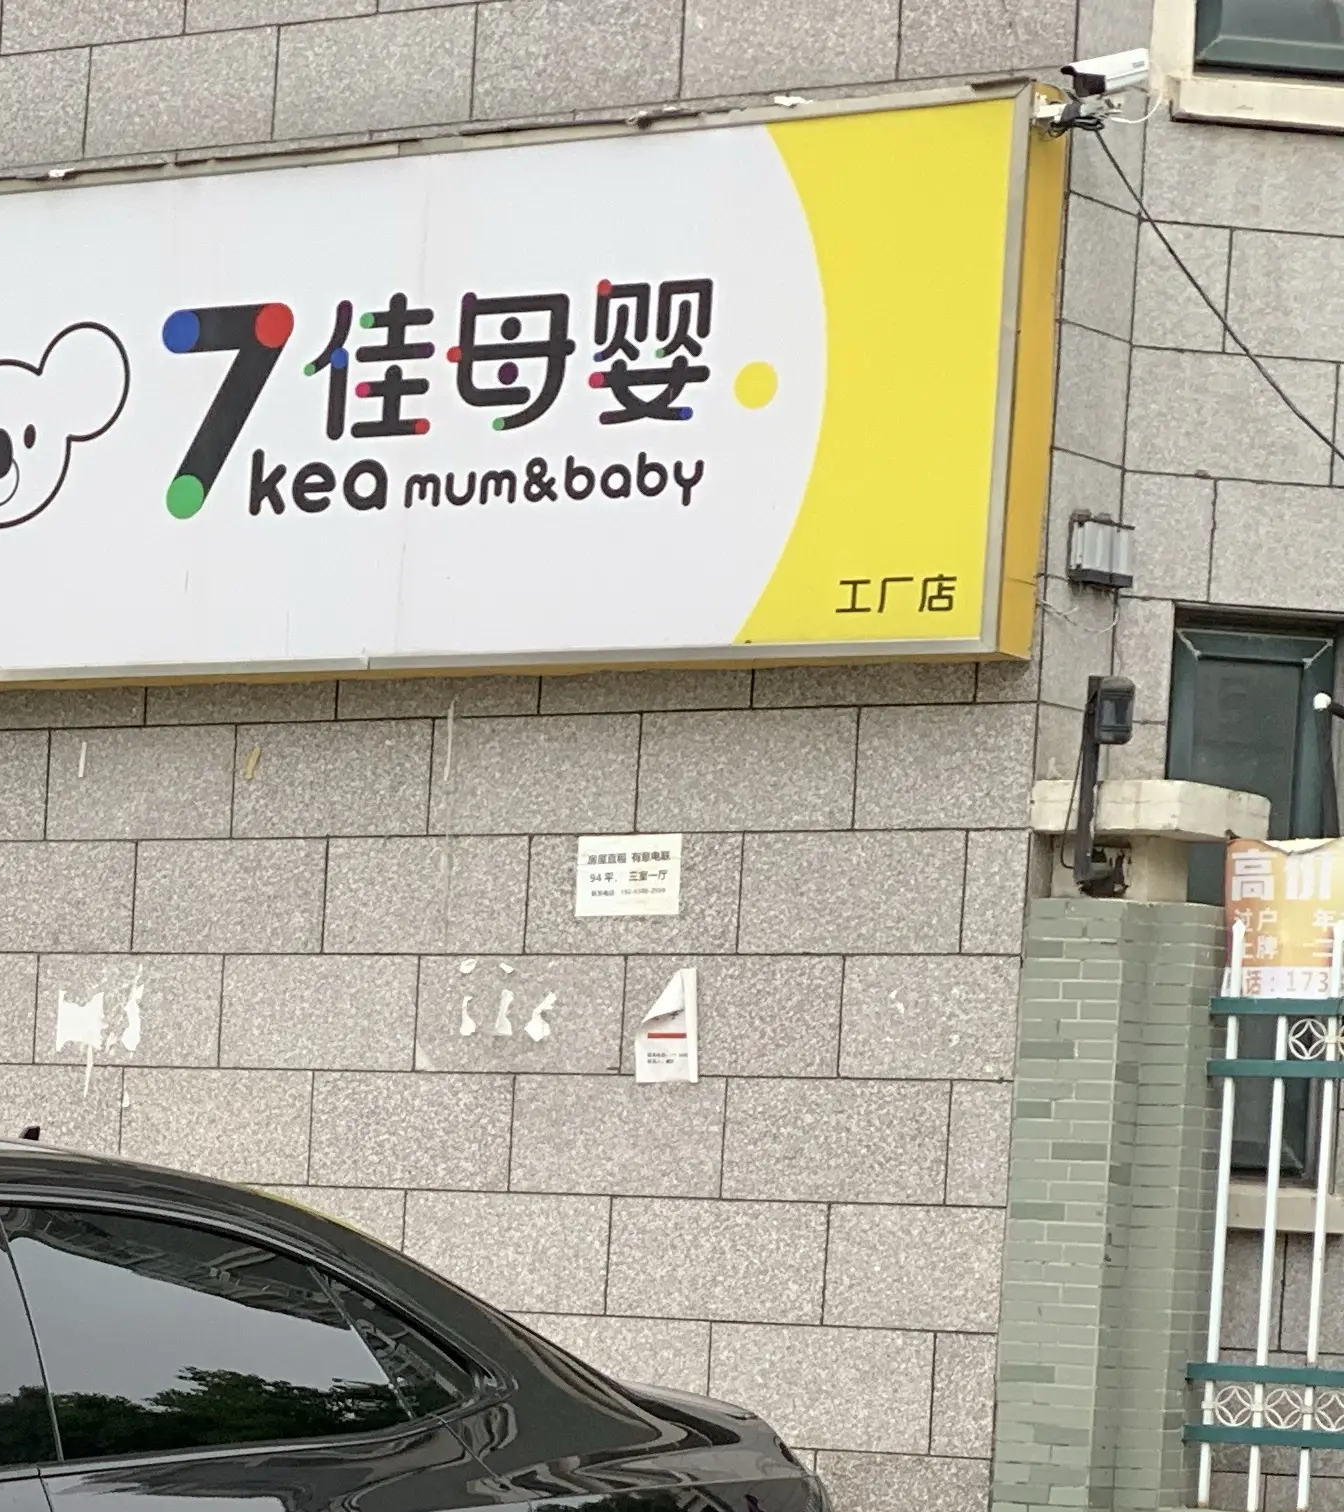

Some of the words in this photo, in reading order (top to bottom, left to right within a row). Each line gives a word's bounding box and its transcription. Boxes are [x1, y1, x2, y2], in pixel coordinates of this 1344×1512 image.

[404, 451, 705, 510] mum&baby
[834, 573, 957, 614] 工厂店
